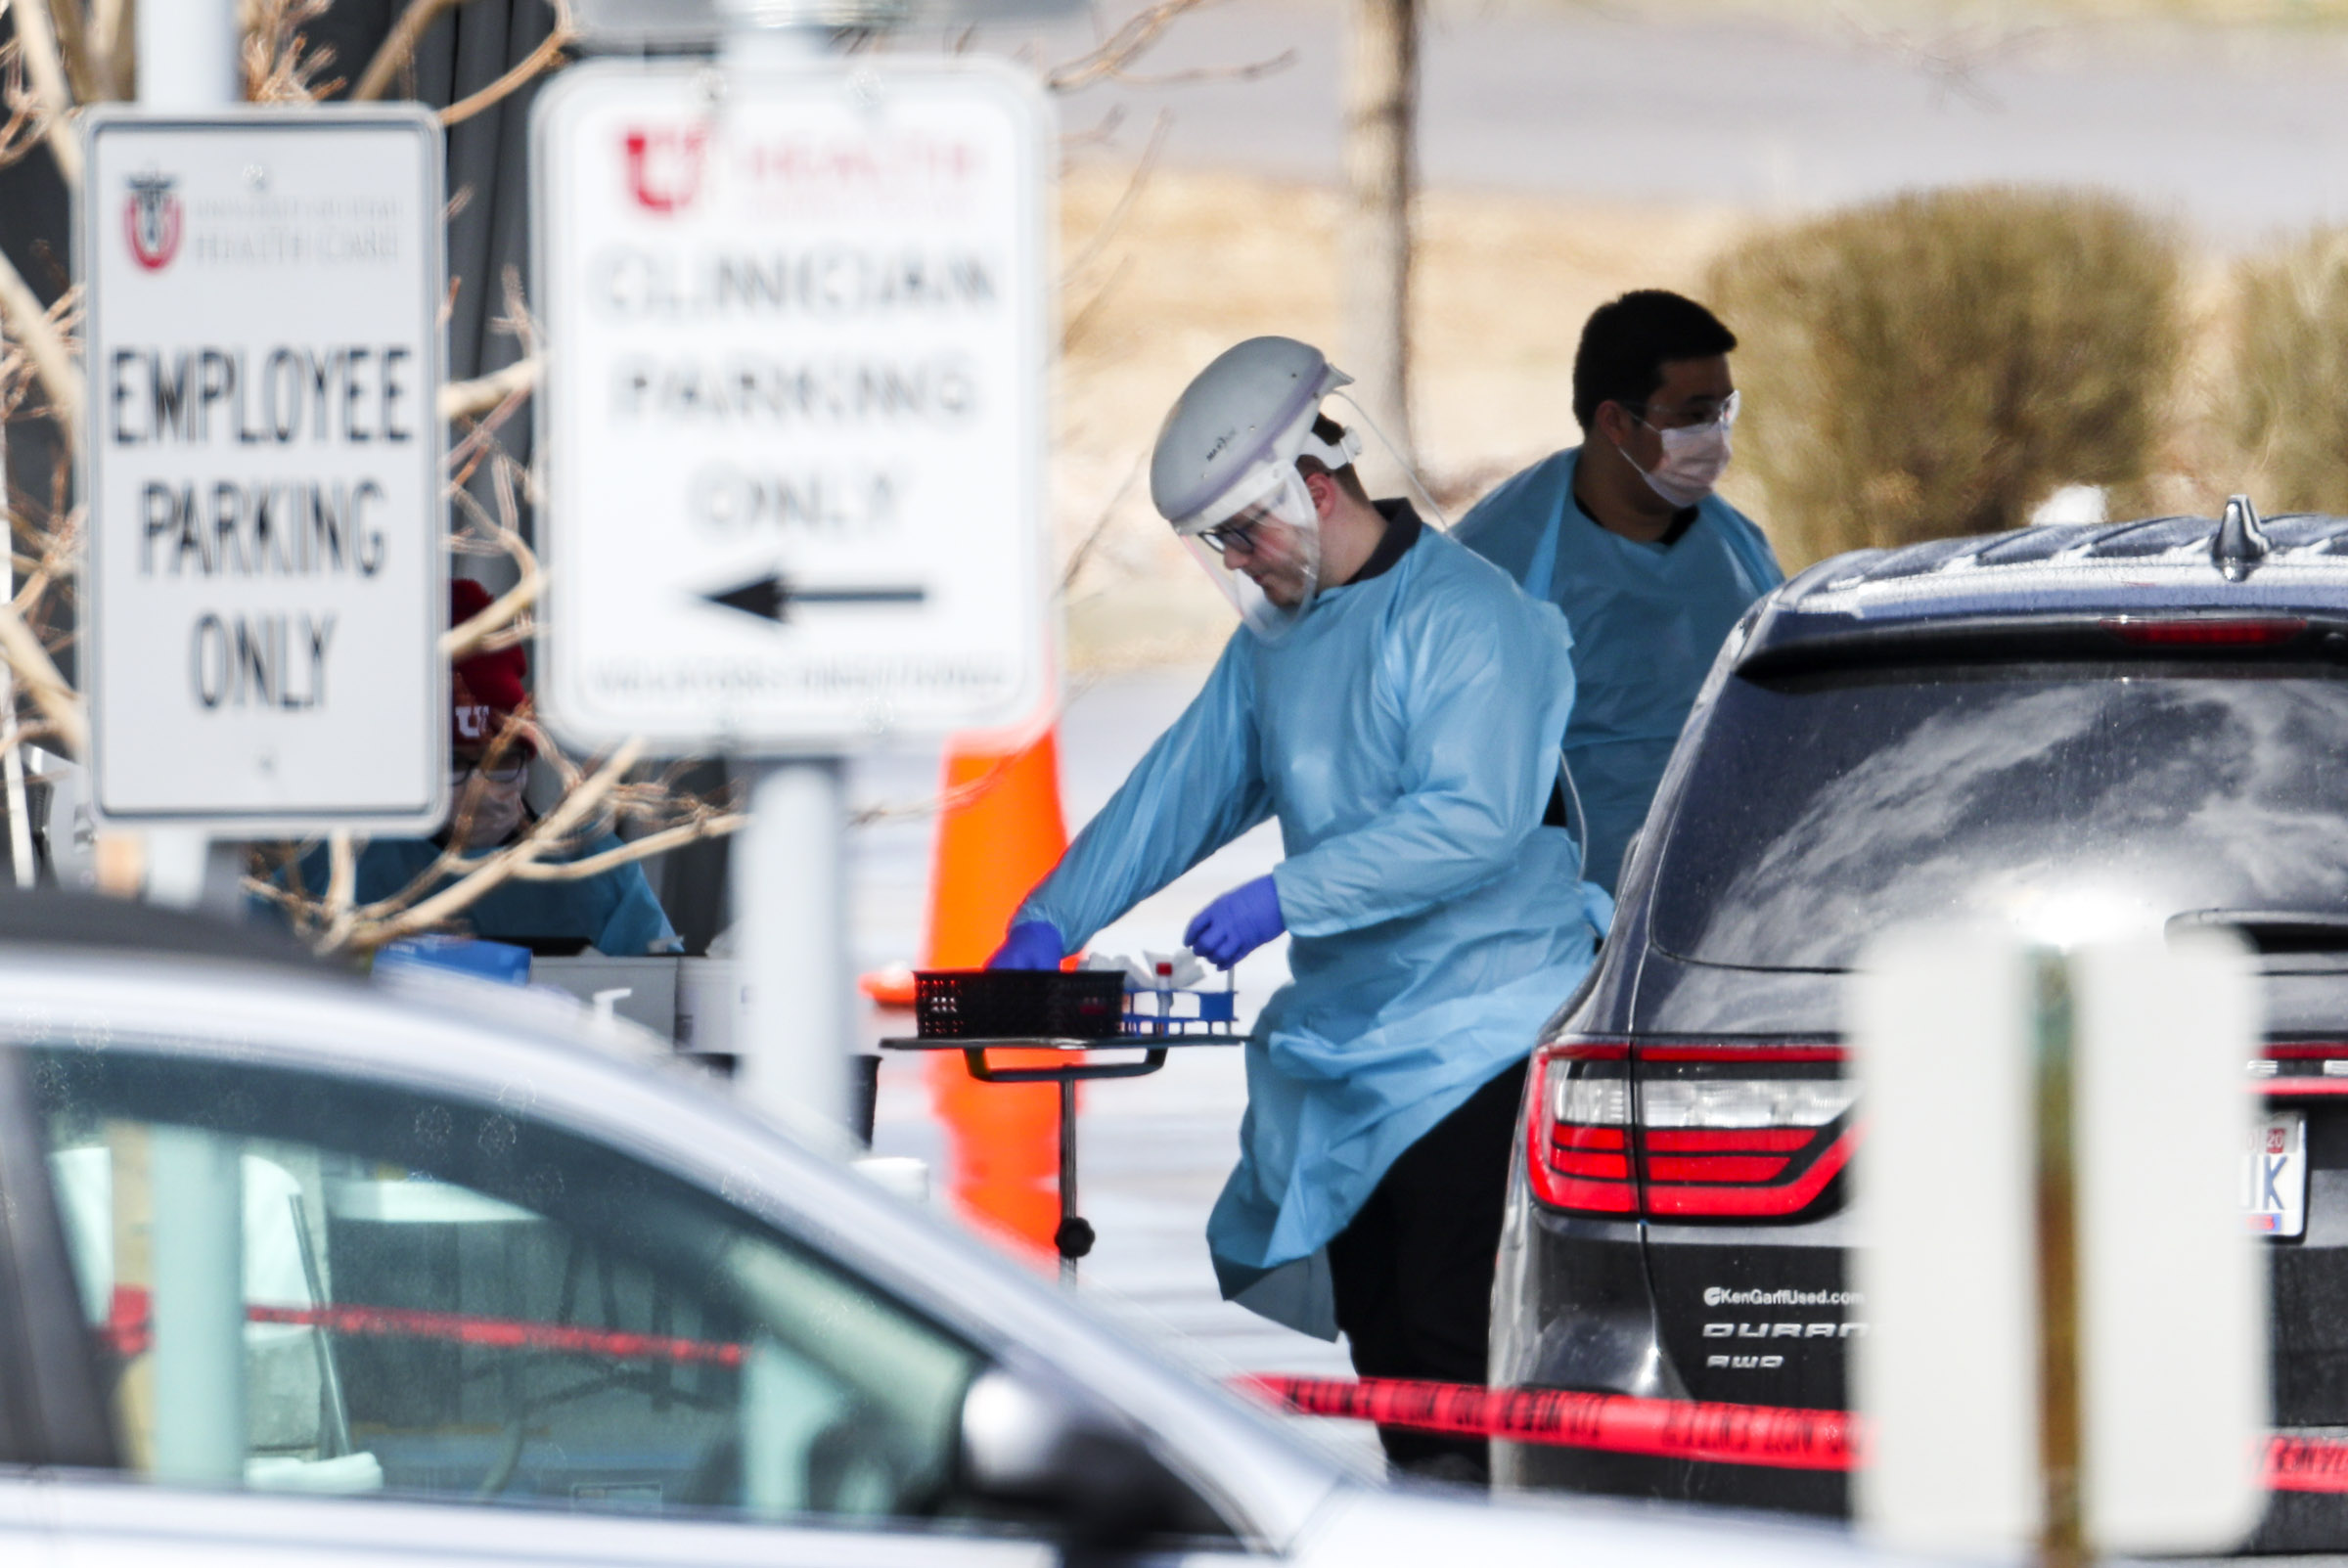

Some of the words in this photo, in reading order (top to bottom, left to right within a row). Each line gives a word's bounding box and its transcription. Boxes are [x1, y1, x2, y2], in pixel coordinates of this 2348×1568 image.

[592, 251, 996, 317] CLINICIAN
[113, 347, 412, 444] EMPLOYEE
[616, 358, 977, 422] PARKING
[141, 480, 385, 578] PARKING
[694, 466, 910, 537] ONLY
[191, 612, 337, 710] ONLY
[1702, 1322, 1871, 1338] DURAN
[1706, 1355, 1784, 1368] AWD
